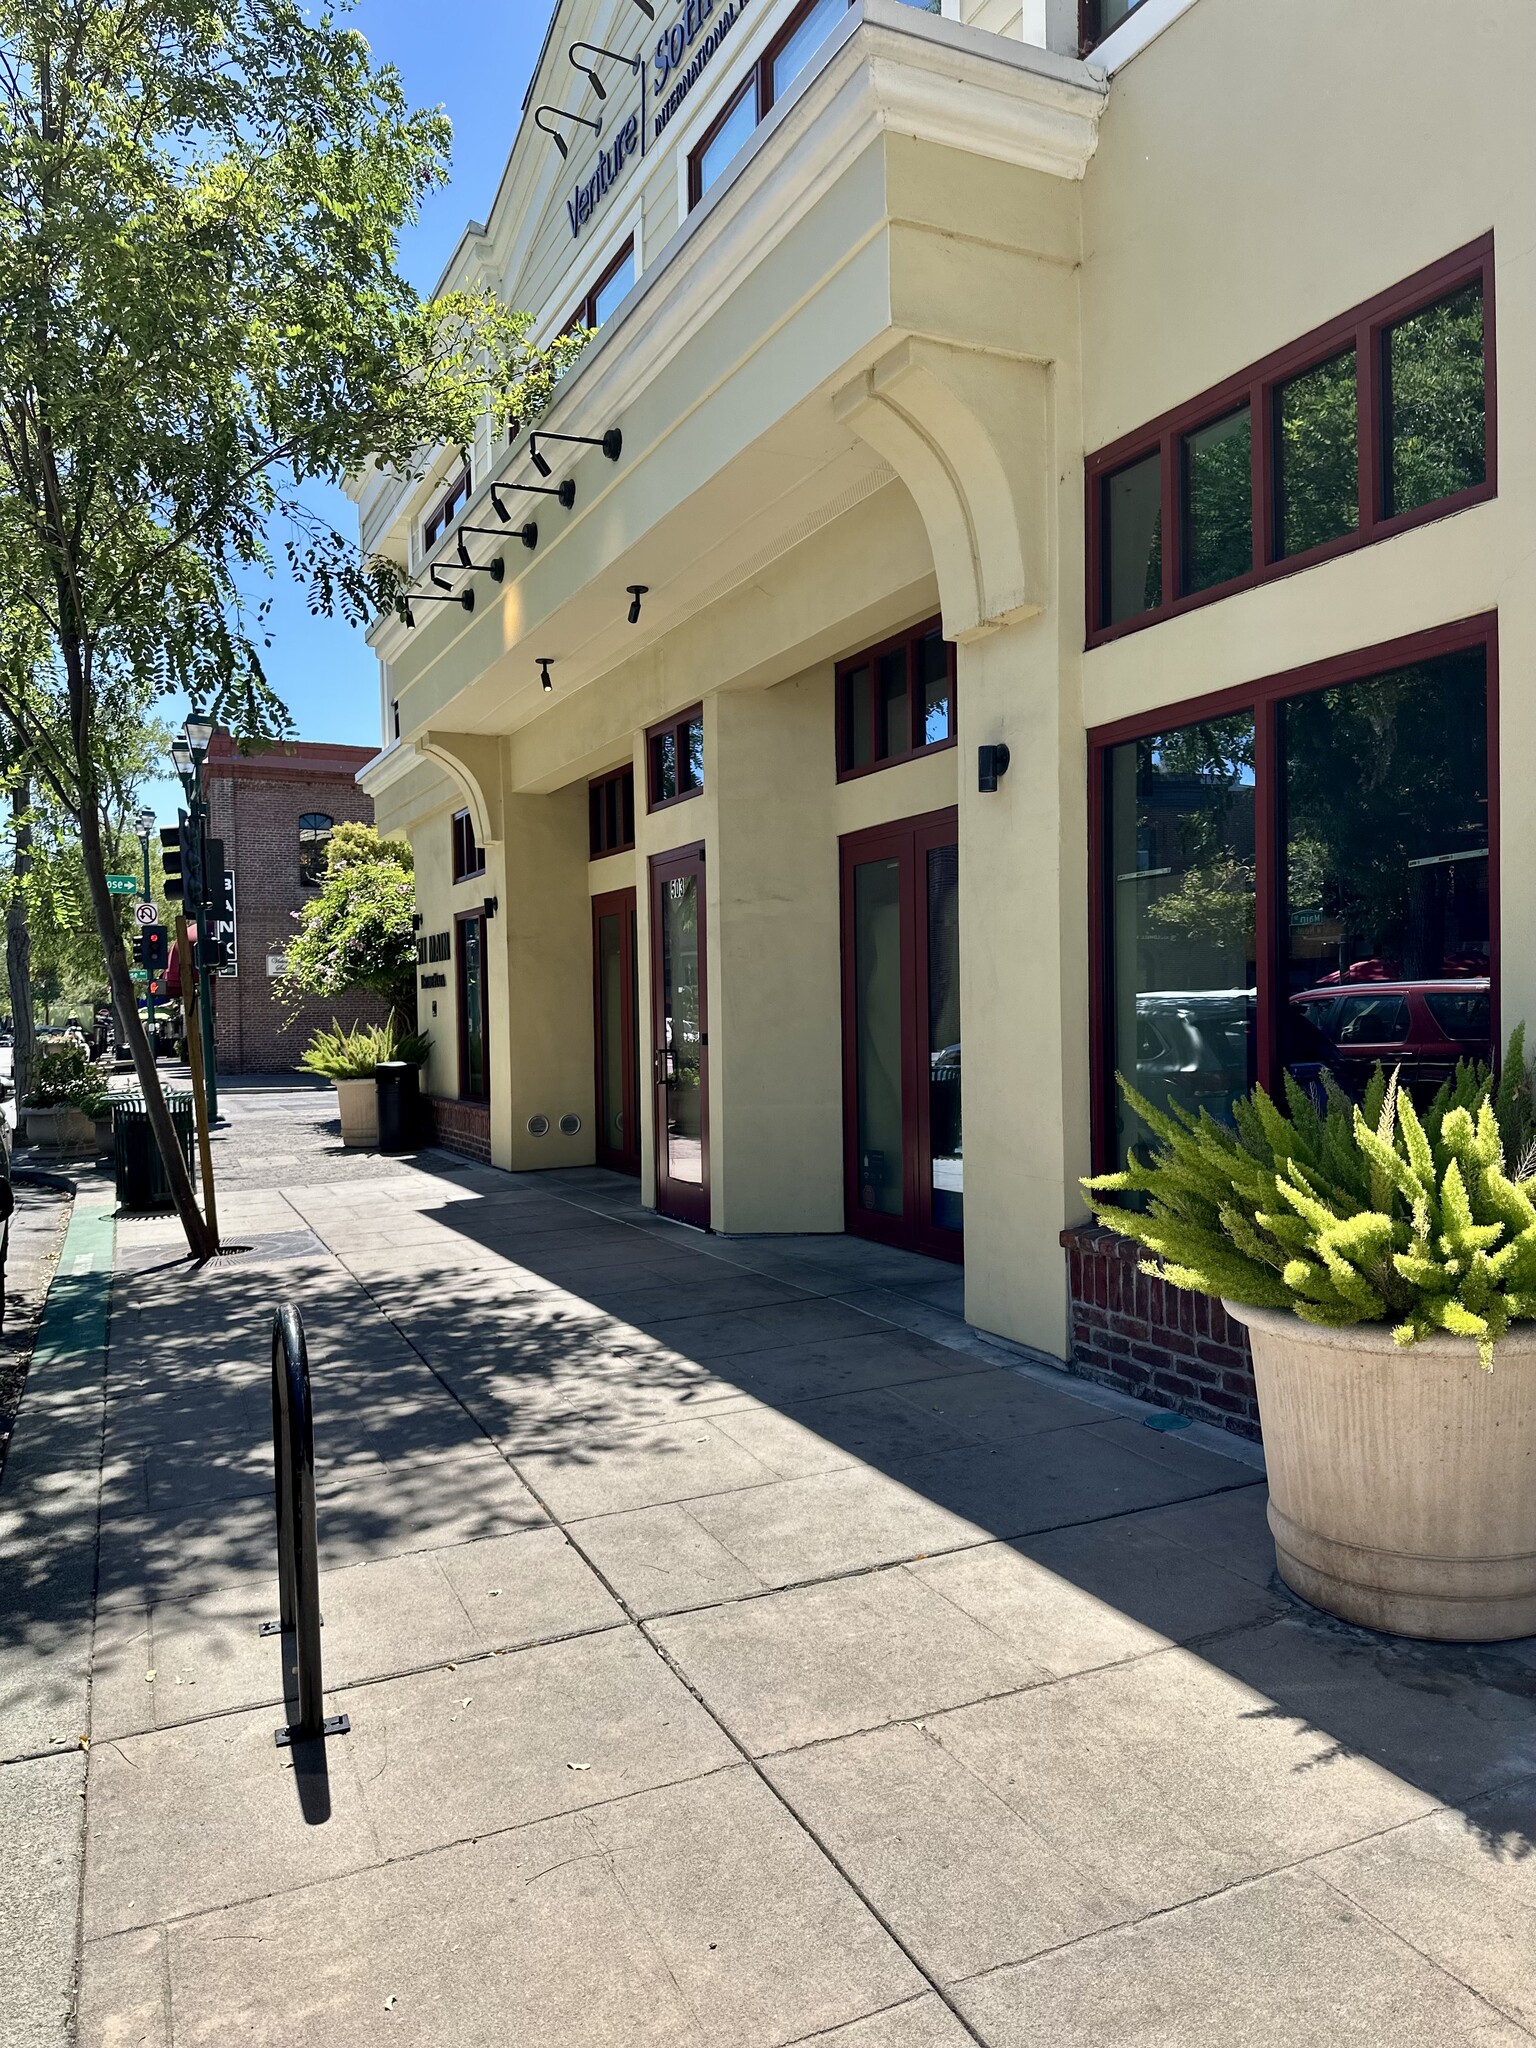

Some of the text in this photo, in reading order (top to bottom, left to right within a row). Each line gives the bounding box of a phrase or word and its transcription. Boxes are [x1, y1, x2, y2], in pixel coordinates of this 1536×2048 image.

[654, 3, 738, 137] INTERNATIONAL
[566, 113, 639, 239] Venture
[106, 880, 123, 889] ose
[671, 877, 684, 899] 503
[428, 931, 451, 964] MAIN
